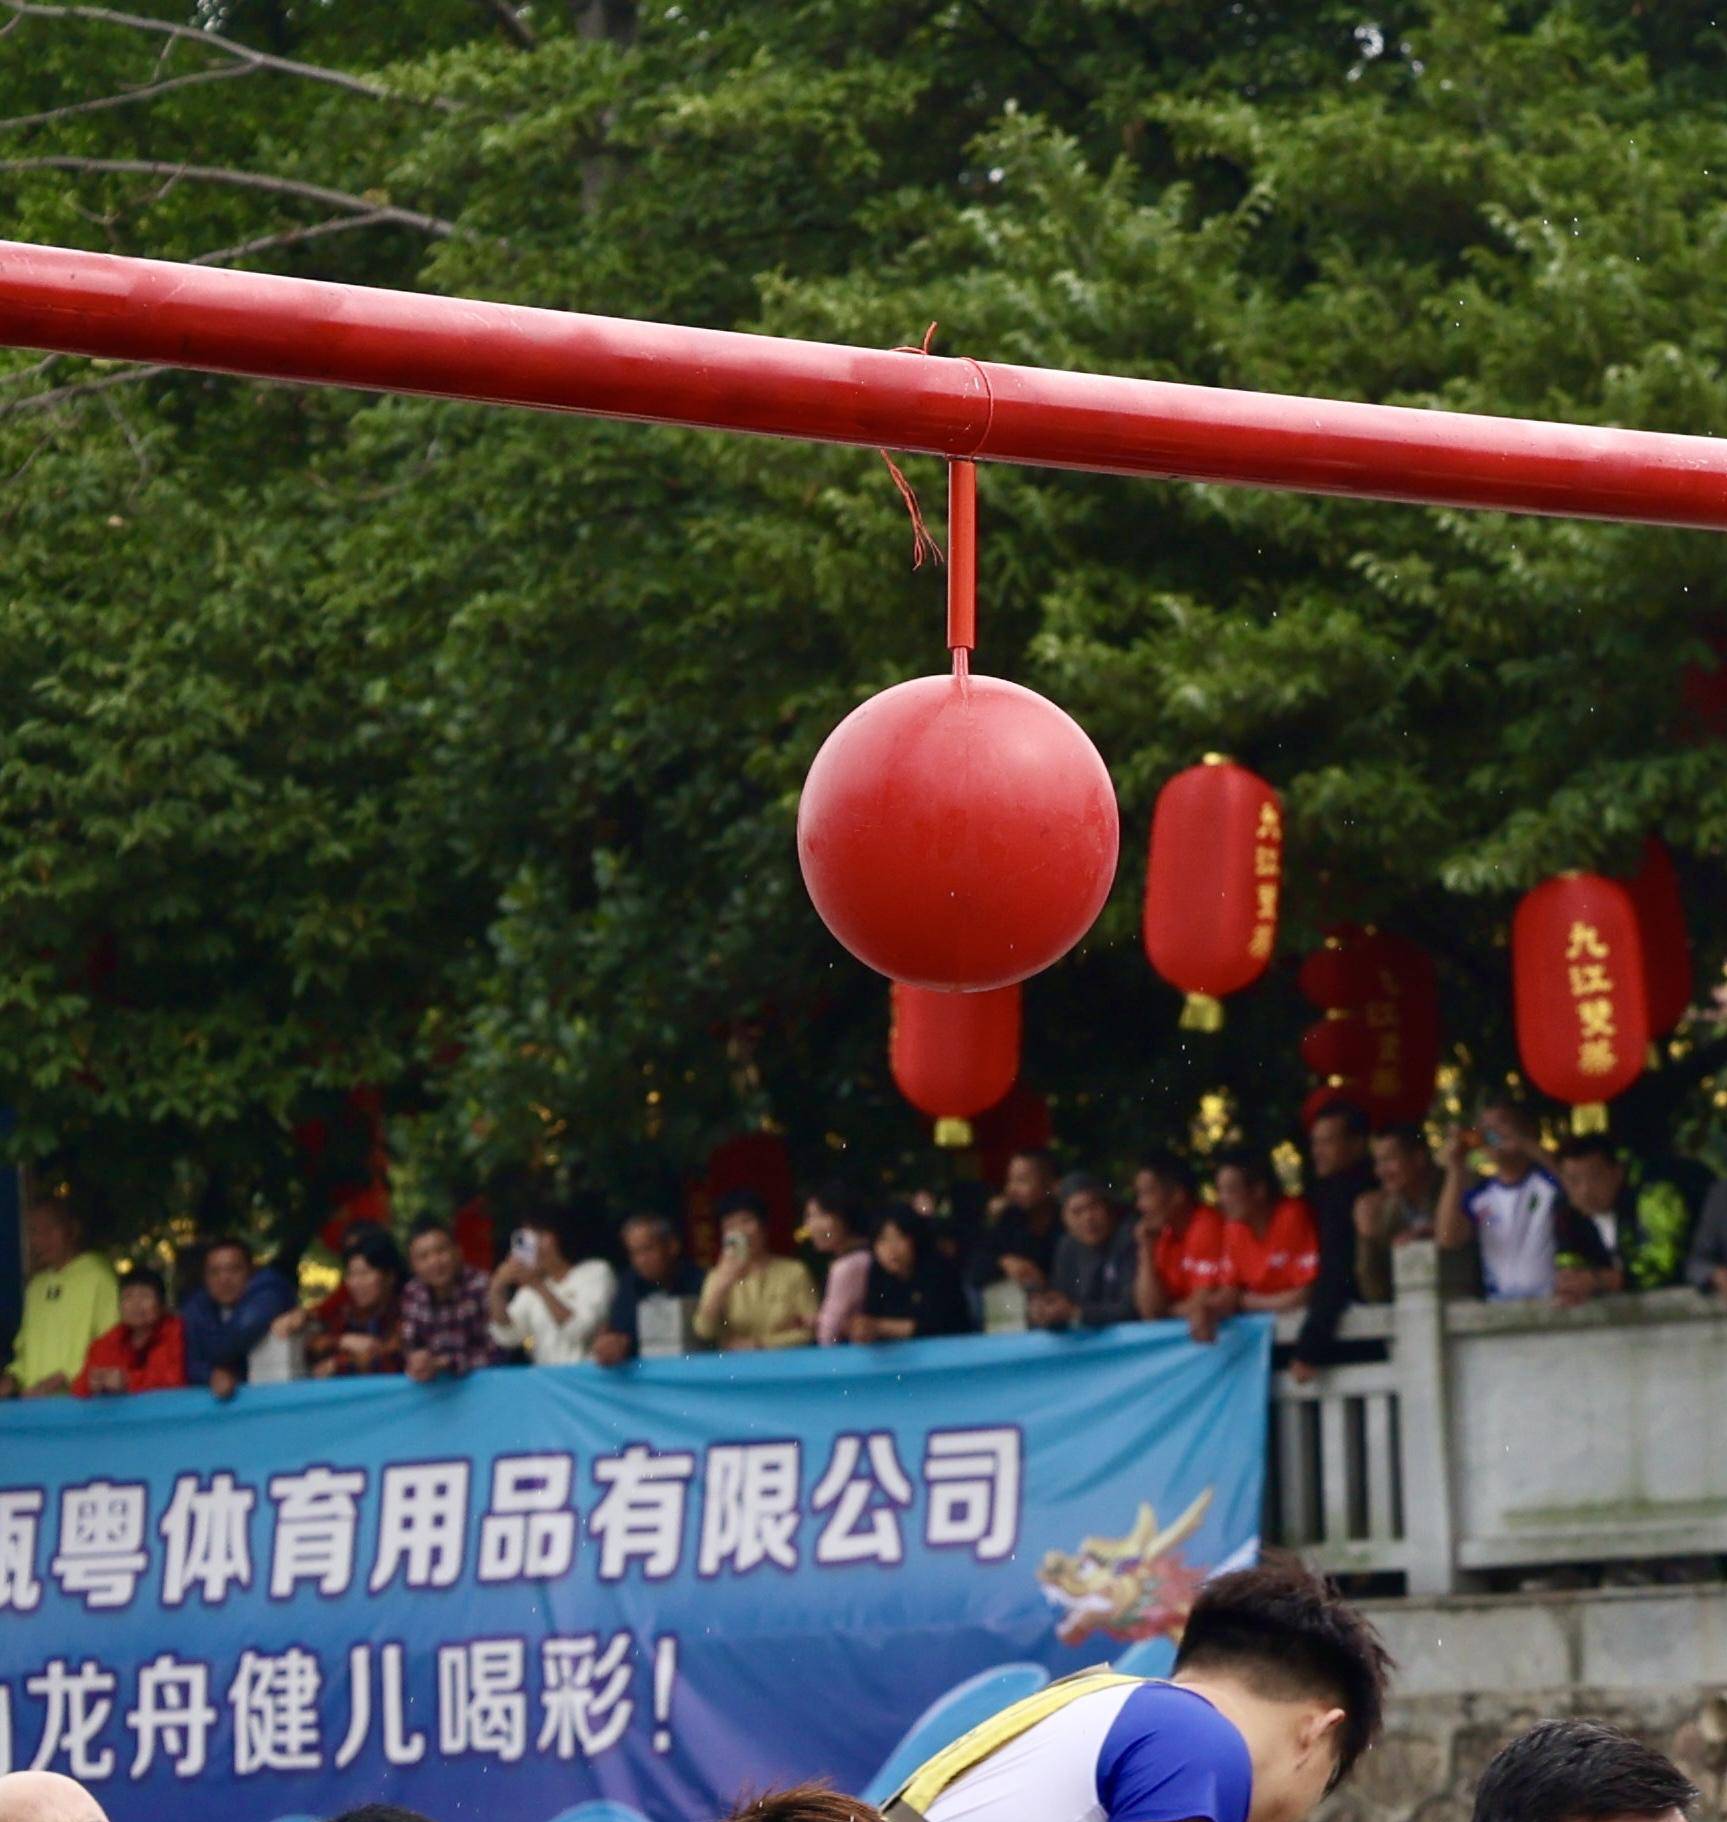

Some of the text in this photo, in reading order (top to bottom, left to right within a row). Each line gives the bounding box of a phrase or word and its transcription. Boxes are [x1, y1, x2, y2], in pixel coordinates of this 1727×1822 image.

[0, 1632, 678, 1782] 龙舟健儿喝彩！
